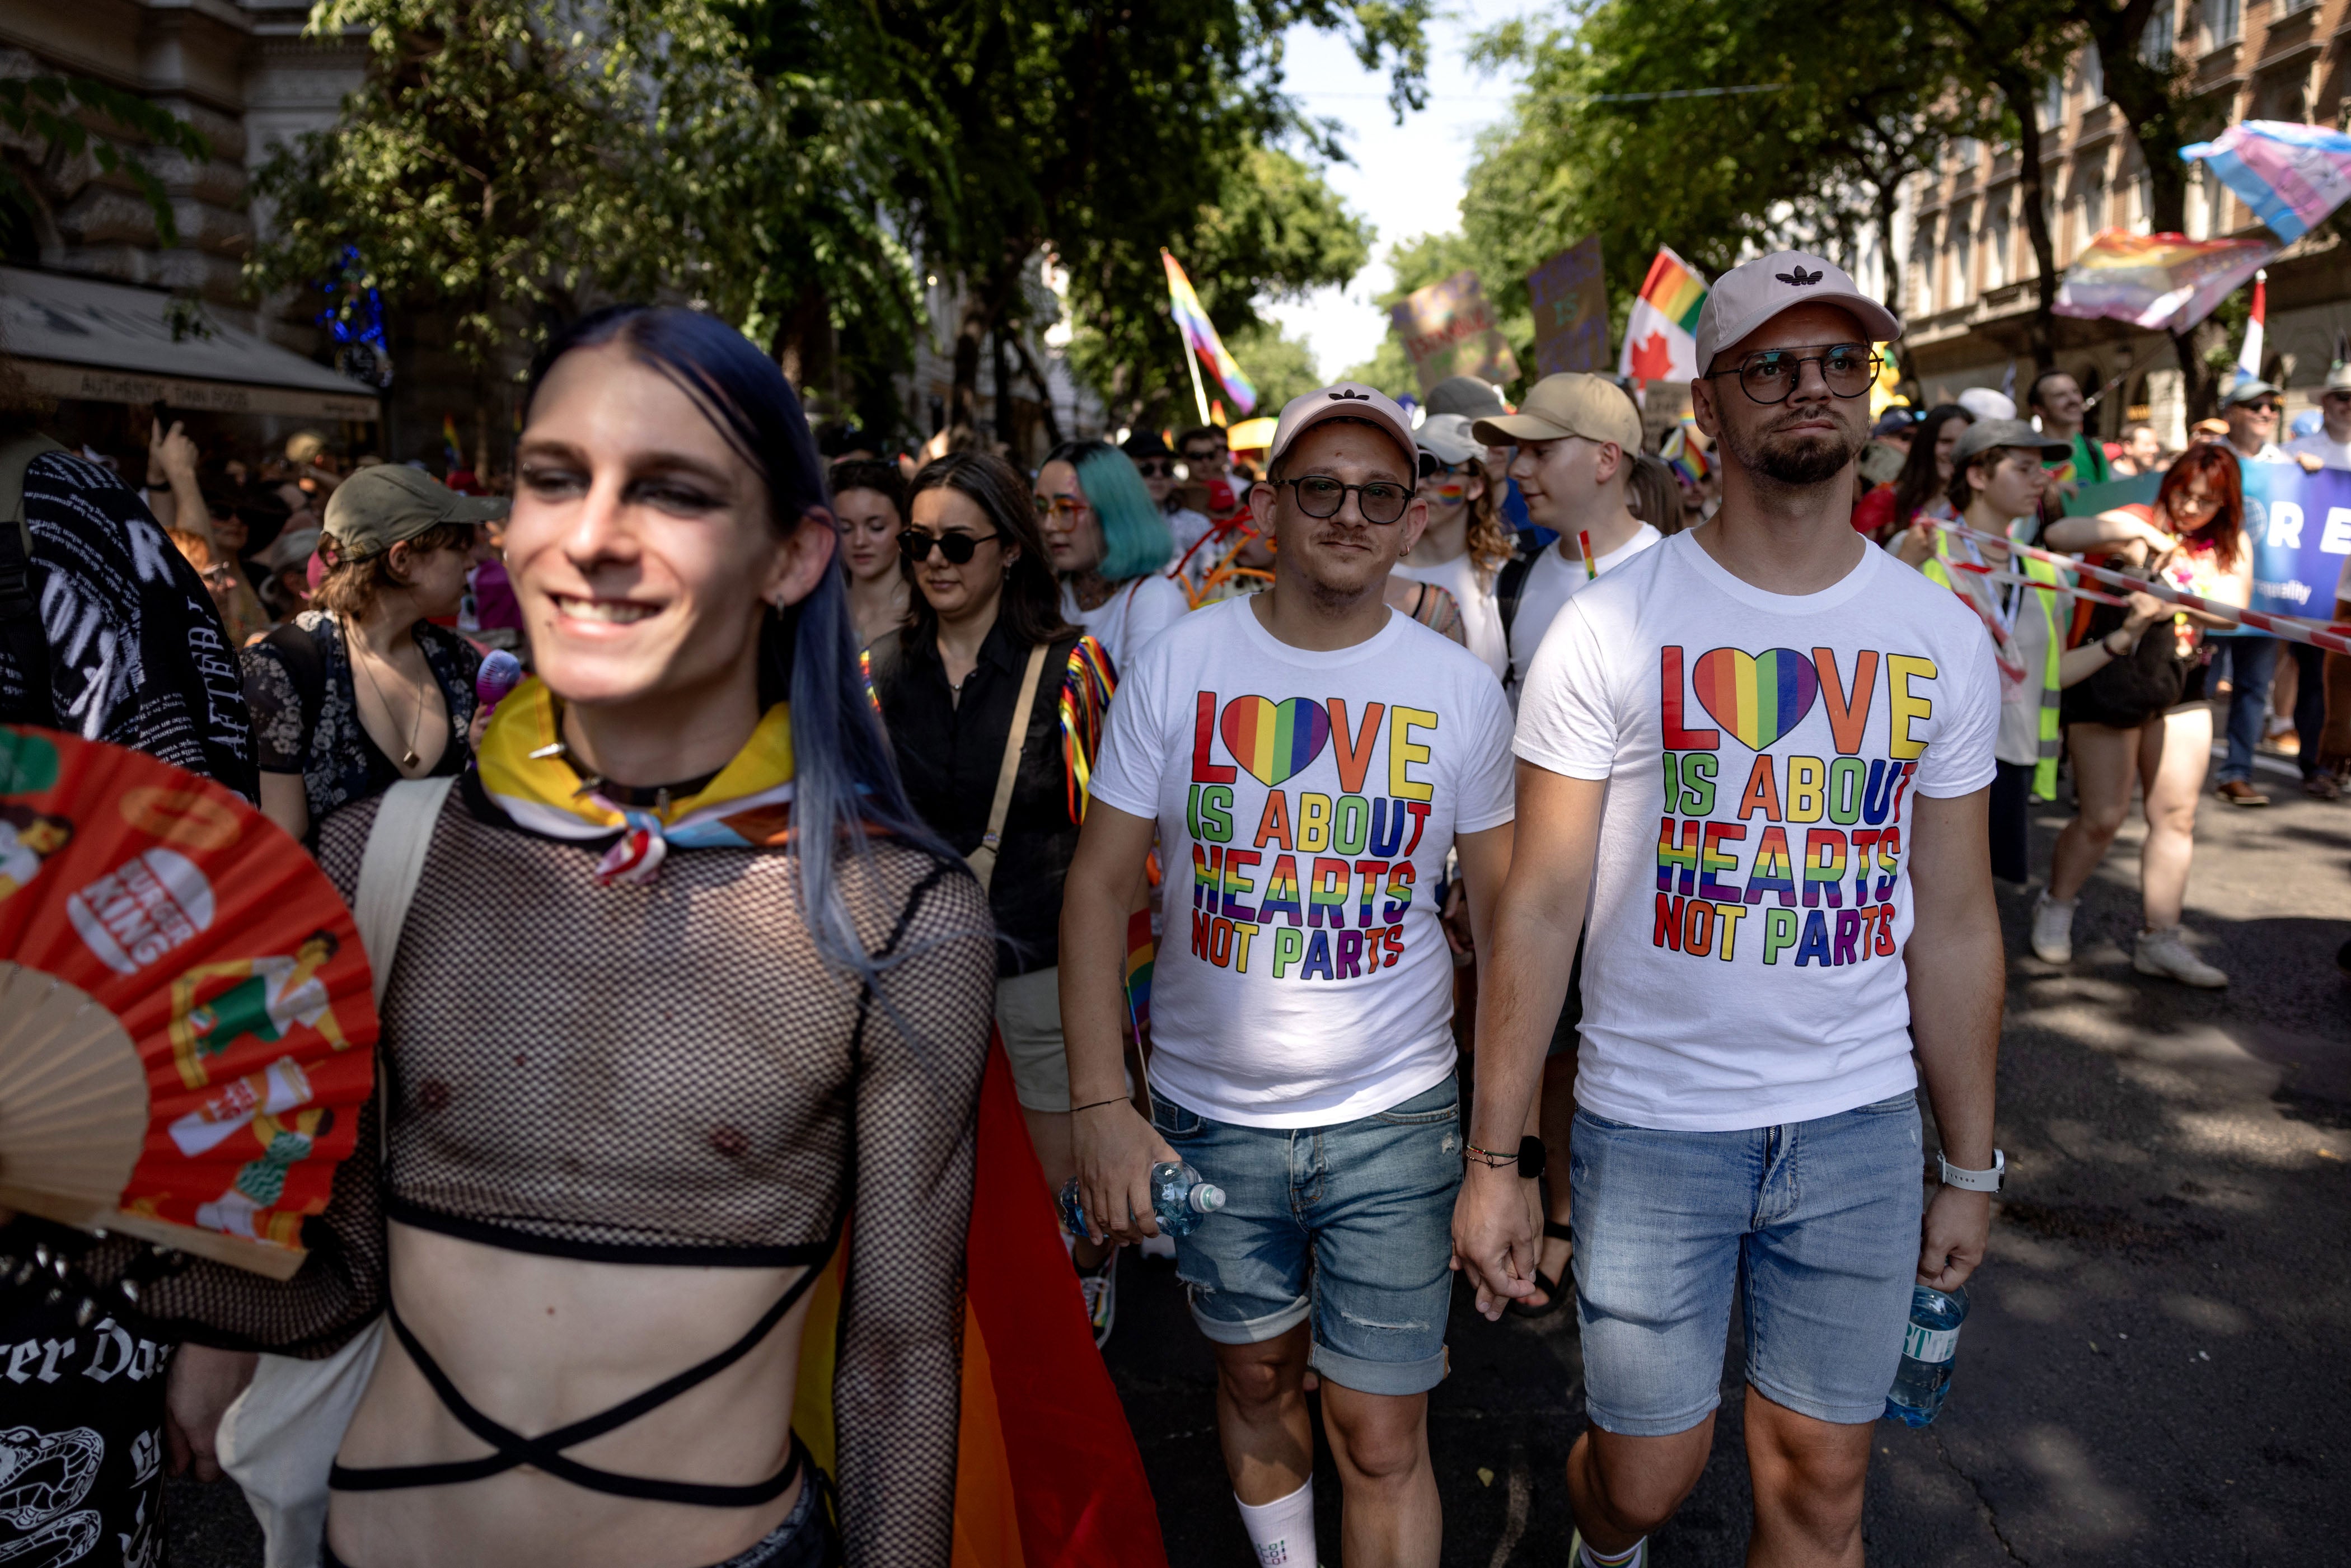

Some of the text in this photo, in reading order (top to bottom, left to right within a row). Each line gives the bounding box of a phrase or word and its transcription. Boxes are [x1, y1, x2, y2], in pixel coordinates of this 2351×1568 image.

[1187, 784, 1431, 857] IS ABOUT
[1662, 752, 1919, 825] IS ABOUT
[1192, 842, 1416, 928] HEARTS
[1656, 817, 1901, 908] HEARTS
[81, 873, 169, 966] KING
[1191, 907, 1404, 980] NOT PARTS
[1653, 892, 1896, 967] NOT PARTS
